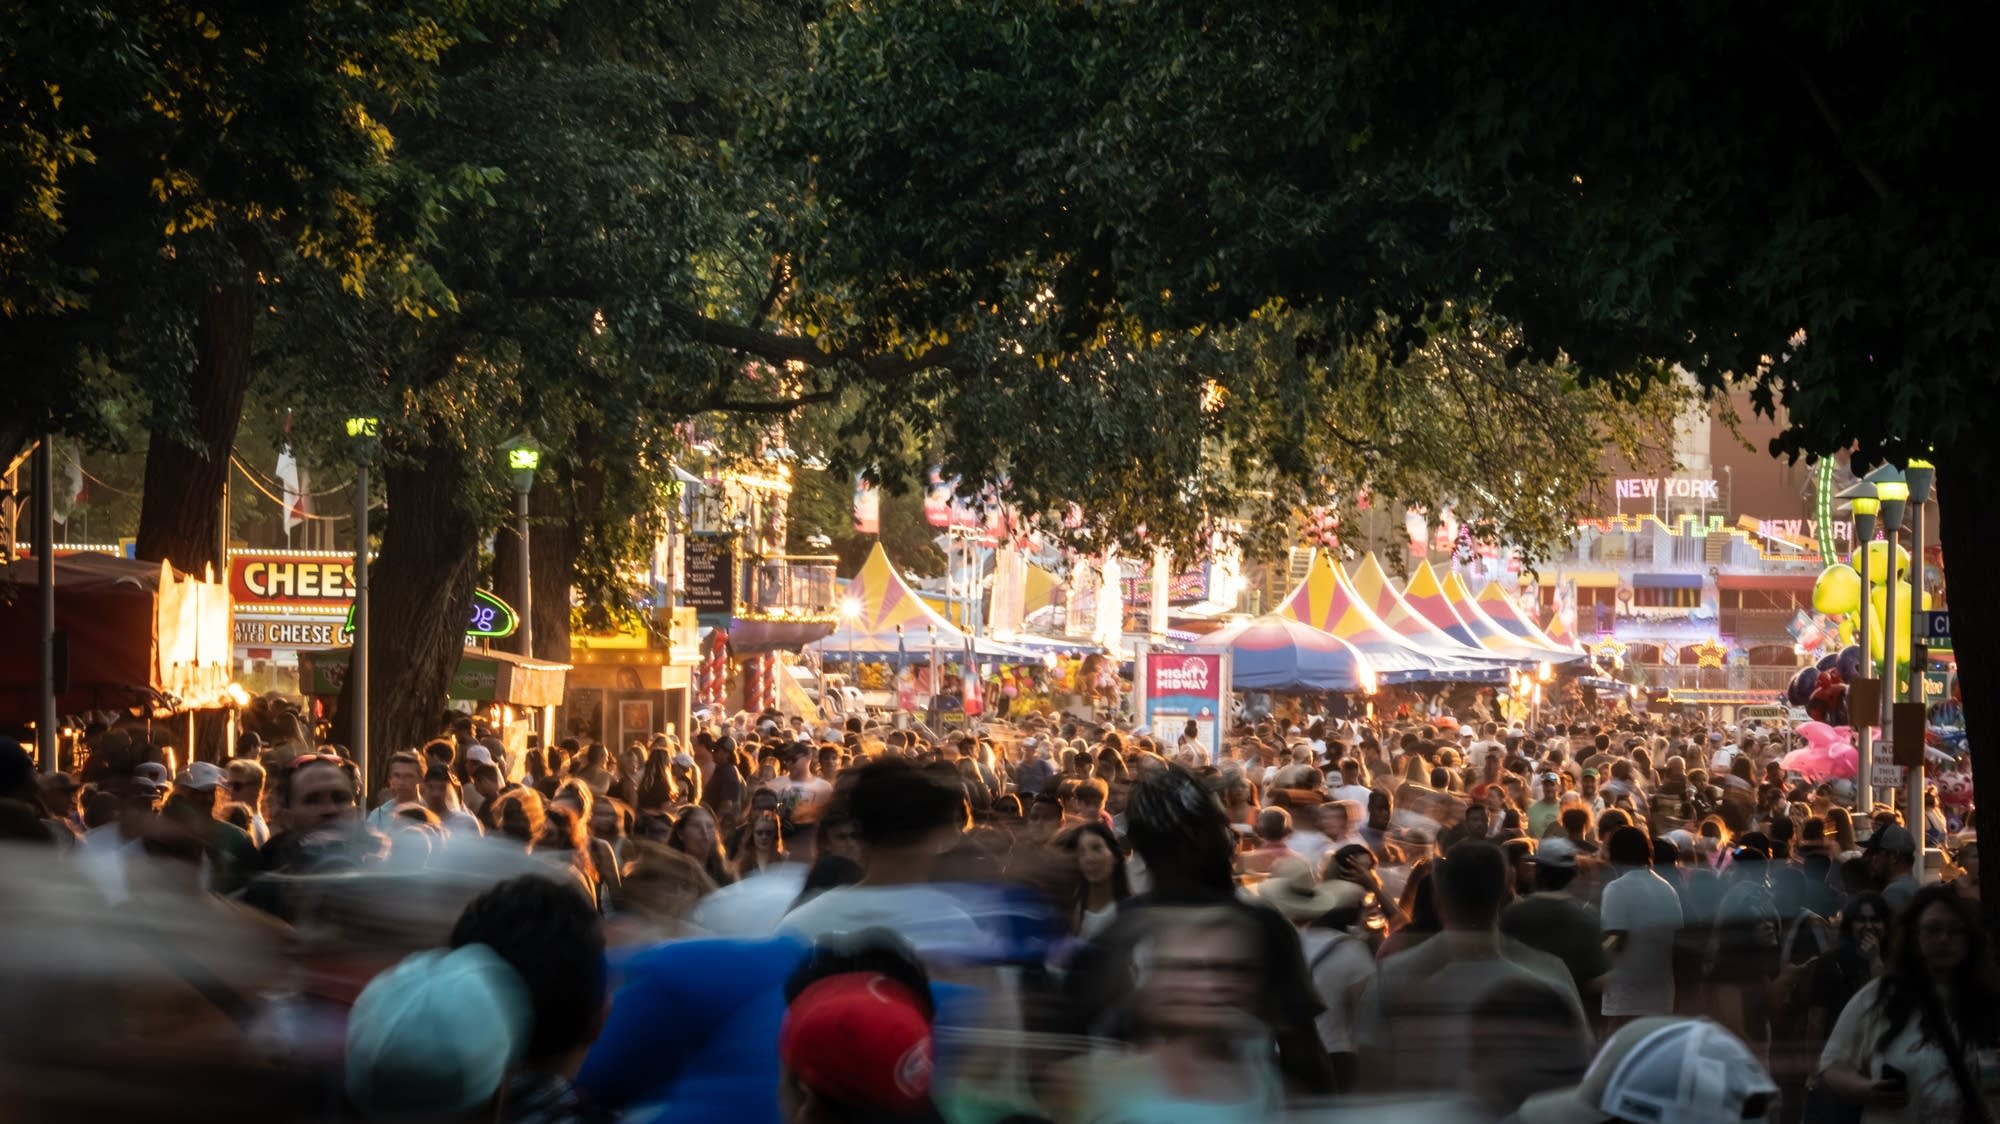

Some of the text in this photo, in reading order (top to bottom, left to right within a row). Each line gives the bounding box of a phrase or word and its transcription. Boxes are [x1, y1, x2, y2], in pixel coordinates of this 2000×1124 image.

[1615, 477, 1718, 499] NEW YORK
[1759, 519, 1852, 540] NEW YR
[234, 622, 265, 633] ATTER
[235, 632, 265, 642] RIED
[268, 624, 332, 645] CHEESE
[1156, 668, 1208, 680] MIGHTY
[1156, 679, 1208, 690] MIDWAY
[1881, 745, 1893, 754] NO
[1873, 776, 1901, 784] BLOCK
